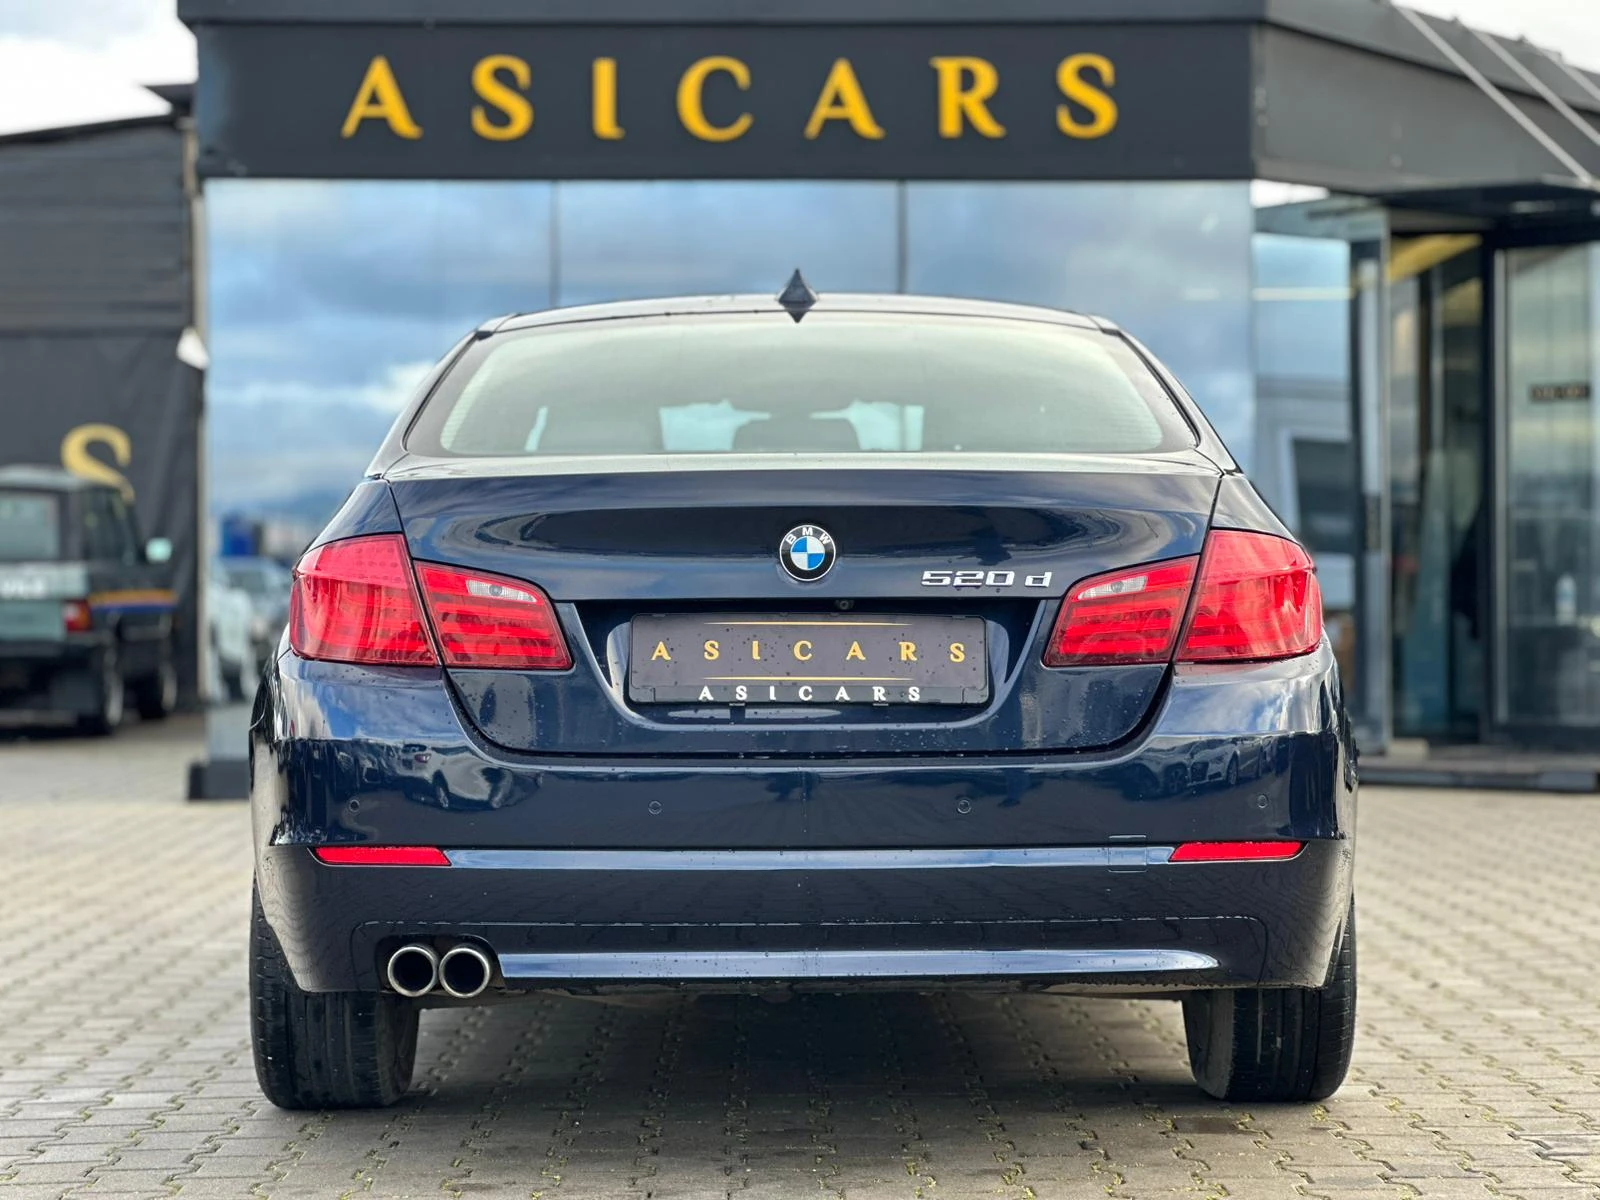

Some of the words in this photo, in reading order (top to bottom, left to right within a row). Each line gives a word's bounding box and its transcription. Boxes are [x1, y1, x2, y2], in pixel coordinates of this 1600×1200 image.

[341, 54, 1118, 141] ASICARS
[785, 527, 831, 545] BMW
[921, 570, 1015, 586] 520
[1024, 571, 1052, 587] d
[651, 640, 966, 663] ASICARS
[699, 685, 921, 702] ASICARS
